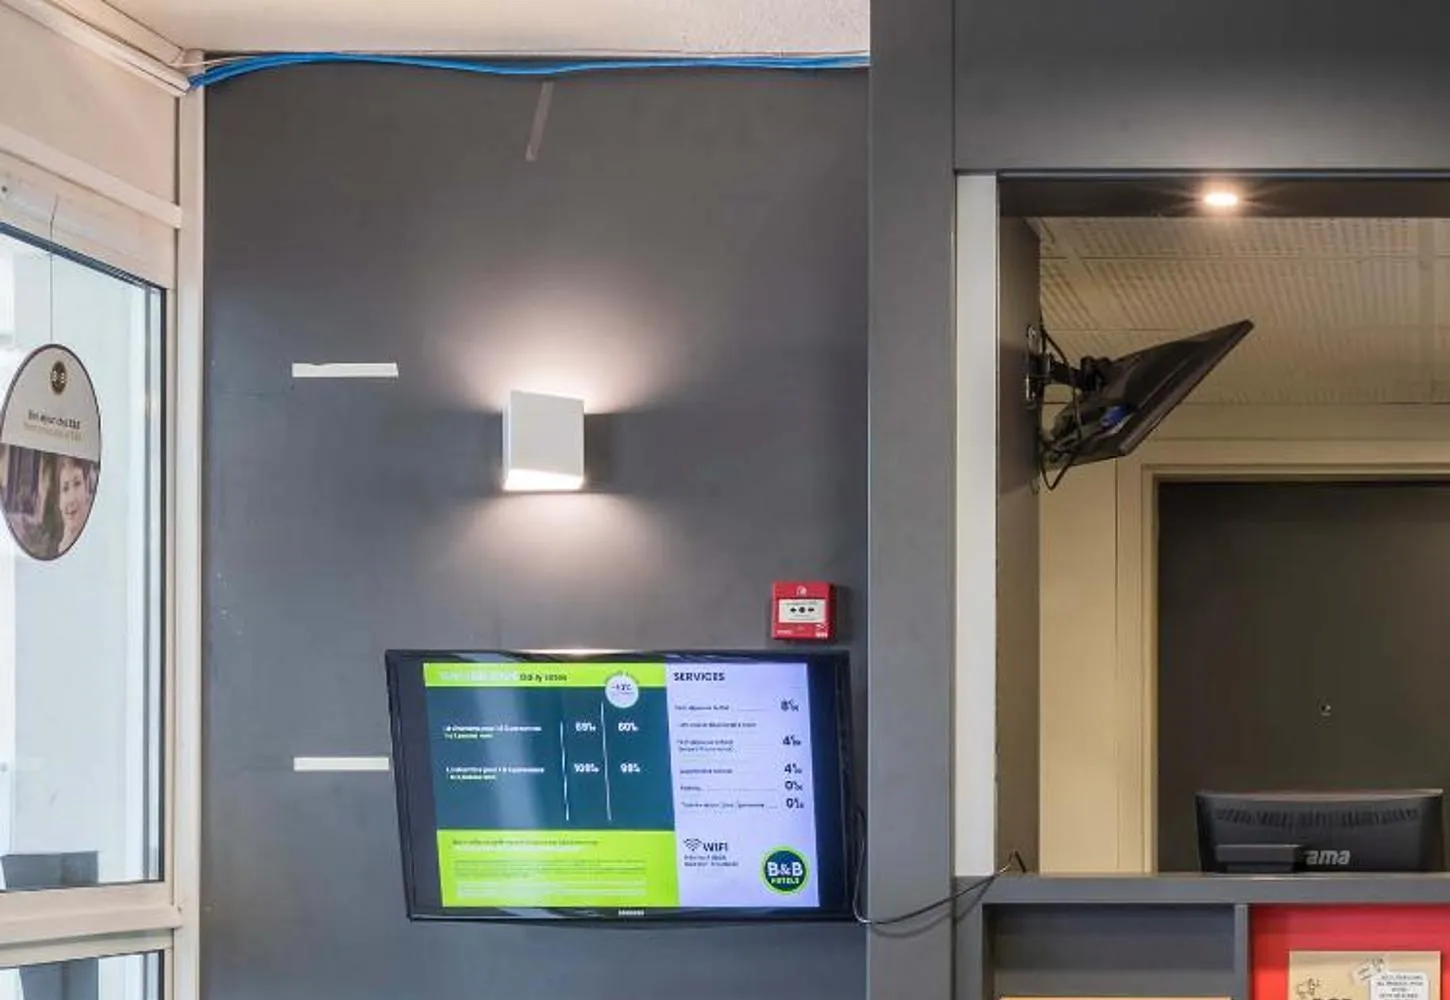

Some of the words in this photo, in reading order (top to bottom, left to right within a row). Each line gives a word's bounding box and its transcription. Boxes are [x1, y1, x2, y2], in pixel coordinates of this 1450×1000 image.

[673, 672, 726, 682] SERVICES
[703, 842, 728, 852] WIFI
[767, 861, 803, 877] B&B
